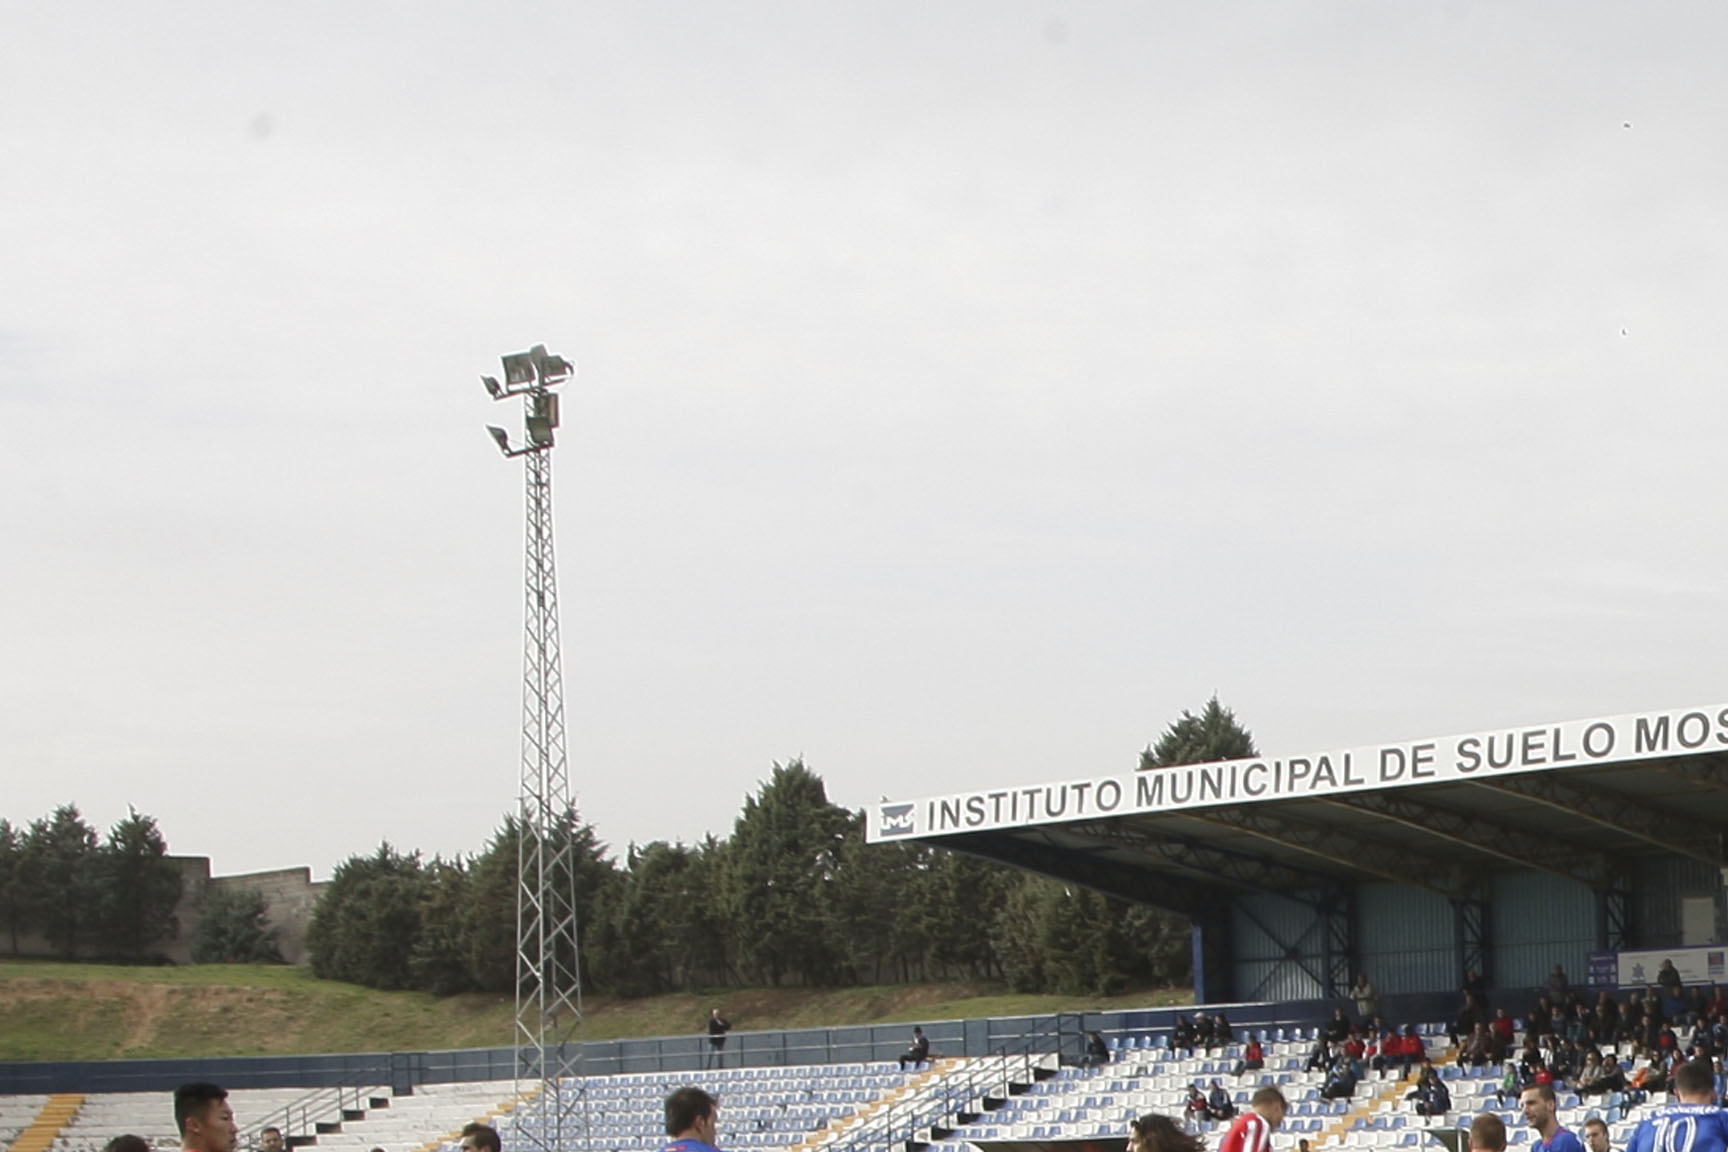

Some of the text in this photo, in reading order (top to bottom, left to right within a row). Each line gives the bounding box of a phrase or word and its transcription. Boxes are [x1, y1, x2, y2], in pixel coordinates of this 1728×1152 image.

[928, 780, 1122, 832] INSTITUTO
[1136, 753, 1364, 808] MUNICIPAL
[1378, 743, 1436, 783] DE
[1456, 722, 1615, 773] SUELO
